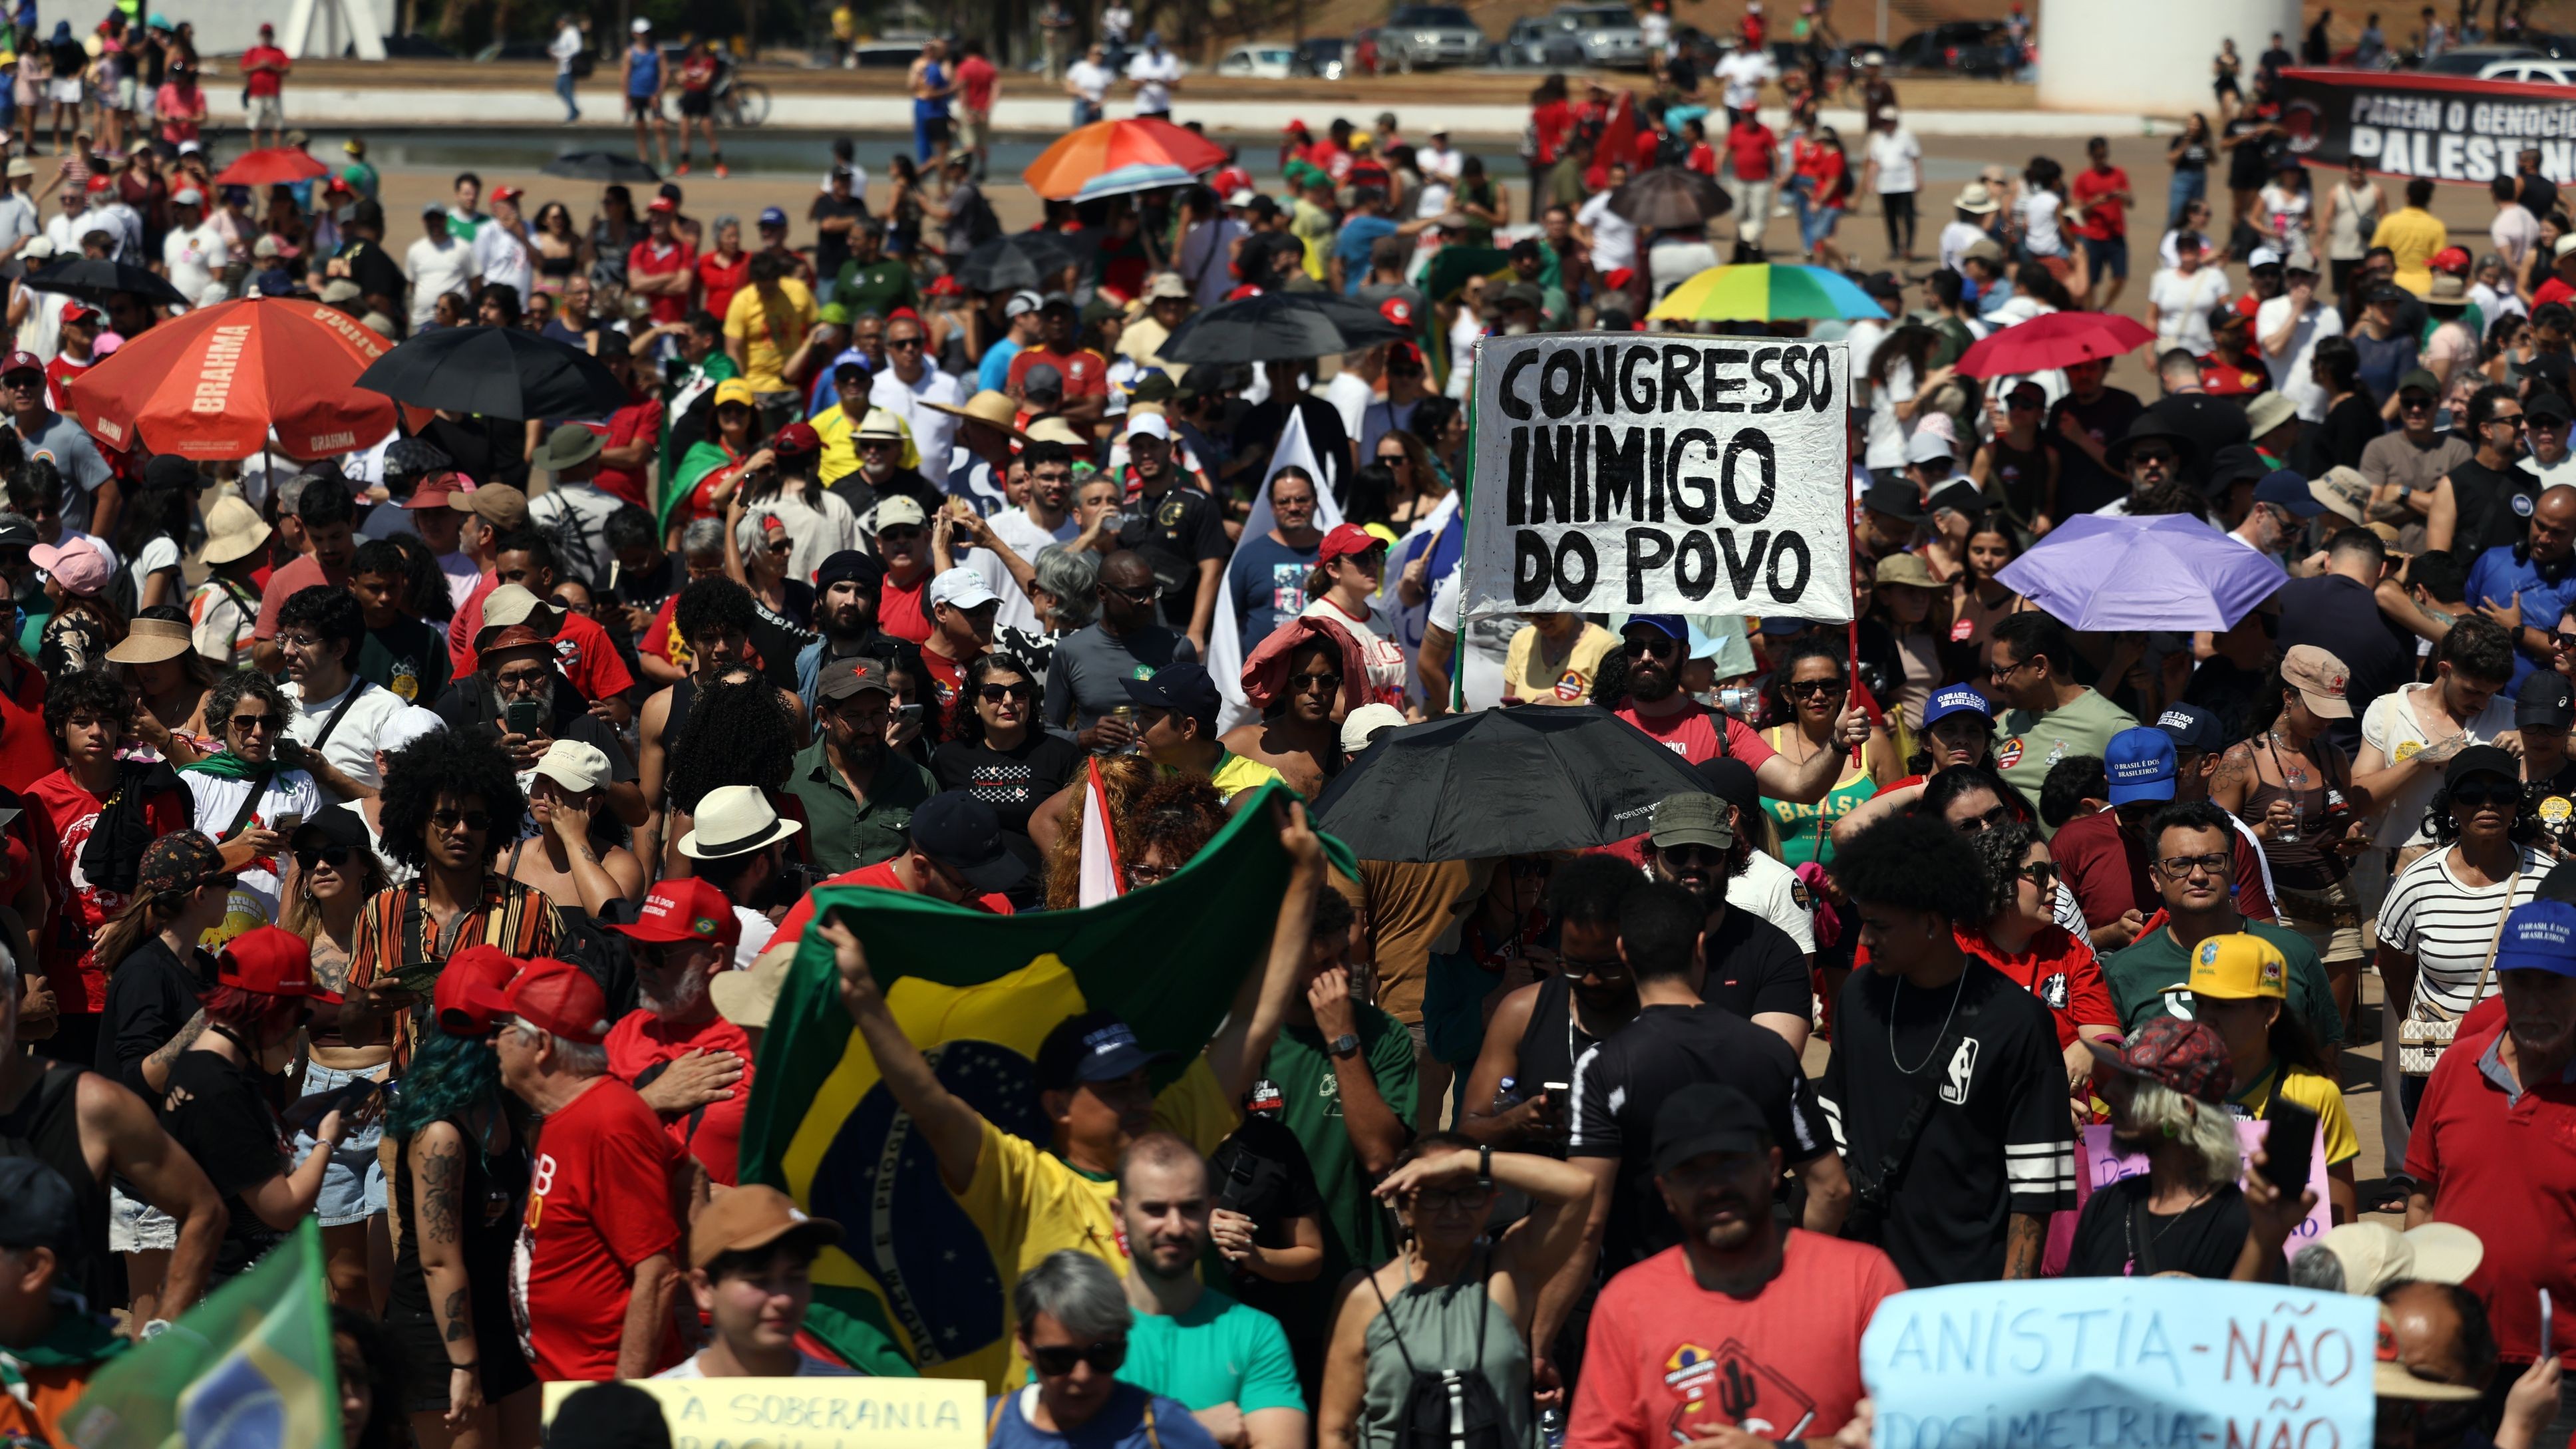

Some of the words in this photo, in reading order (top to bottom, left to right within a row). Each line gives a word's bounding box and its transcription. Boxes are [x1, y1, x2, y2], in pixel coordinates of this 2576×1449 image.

[2351, 95, 2442, 132] PAREM
[2446, 101, 2466, 132] O
[192, 325, 251, 413] BRAHMA
[1500, 344, 1831, 420] CONGRESSO
[311, 431, 355, 452] BRAHMA
[1506, 425, 1776, 526] INIMIGO
[1514, 530, 1598, 606] DO
[1625, 527, 1811, 604] POVO
[1943, 692, 1969, 701] BRASIL
[2177, 713, 2194, 724] DOS
[2118, 767, 2158, 778] BRASILEIROS
[2119, 762, 2142, 770] BRASIL
[1613, 806, 1650, 821] PROFILTER
[1943, 1084, 1957, 1098] NBA
[679, 1385, 708, 1424] À
[728, 1392, 963, 1431] SOBERANIA
